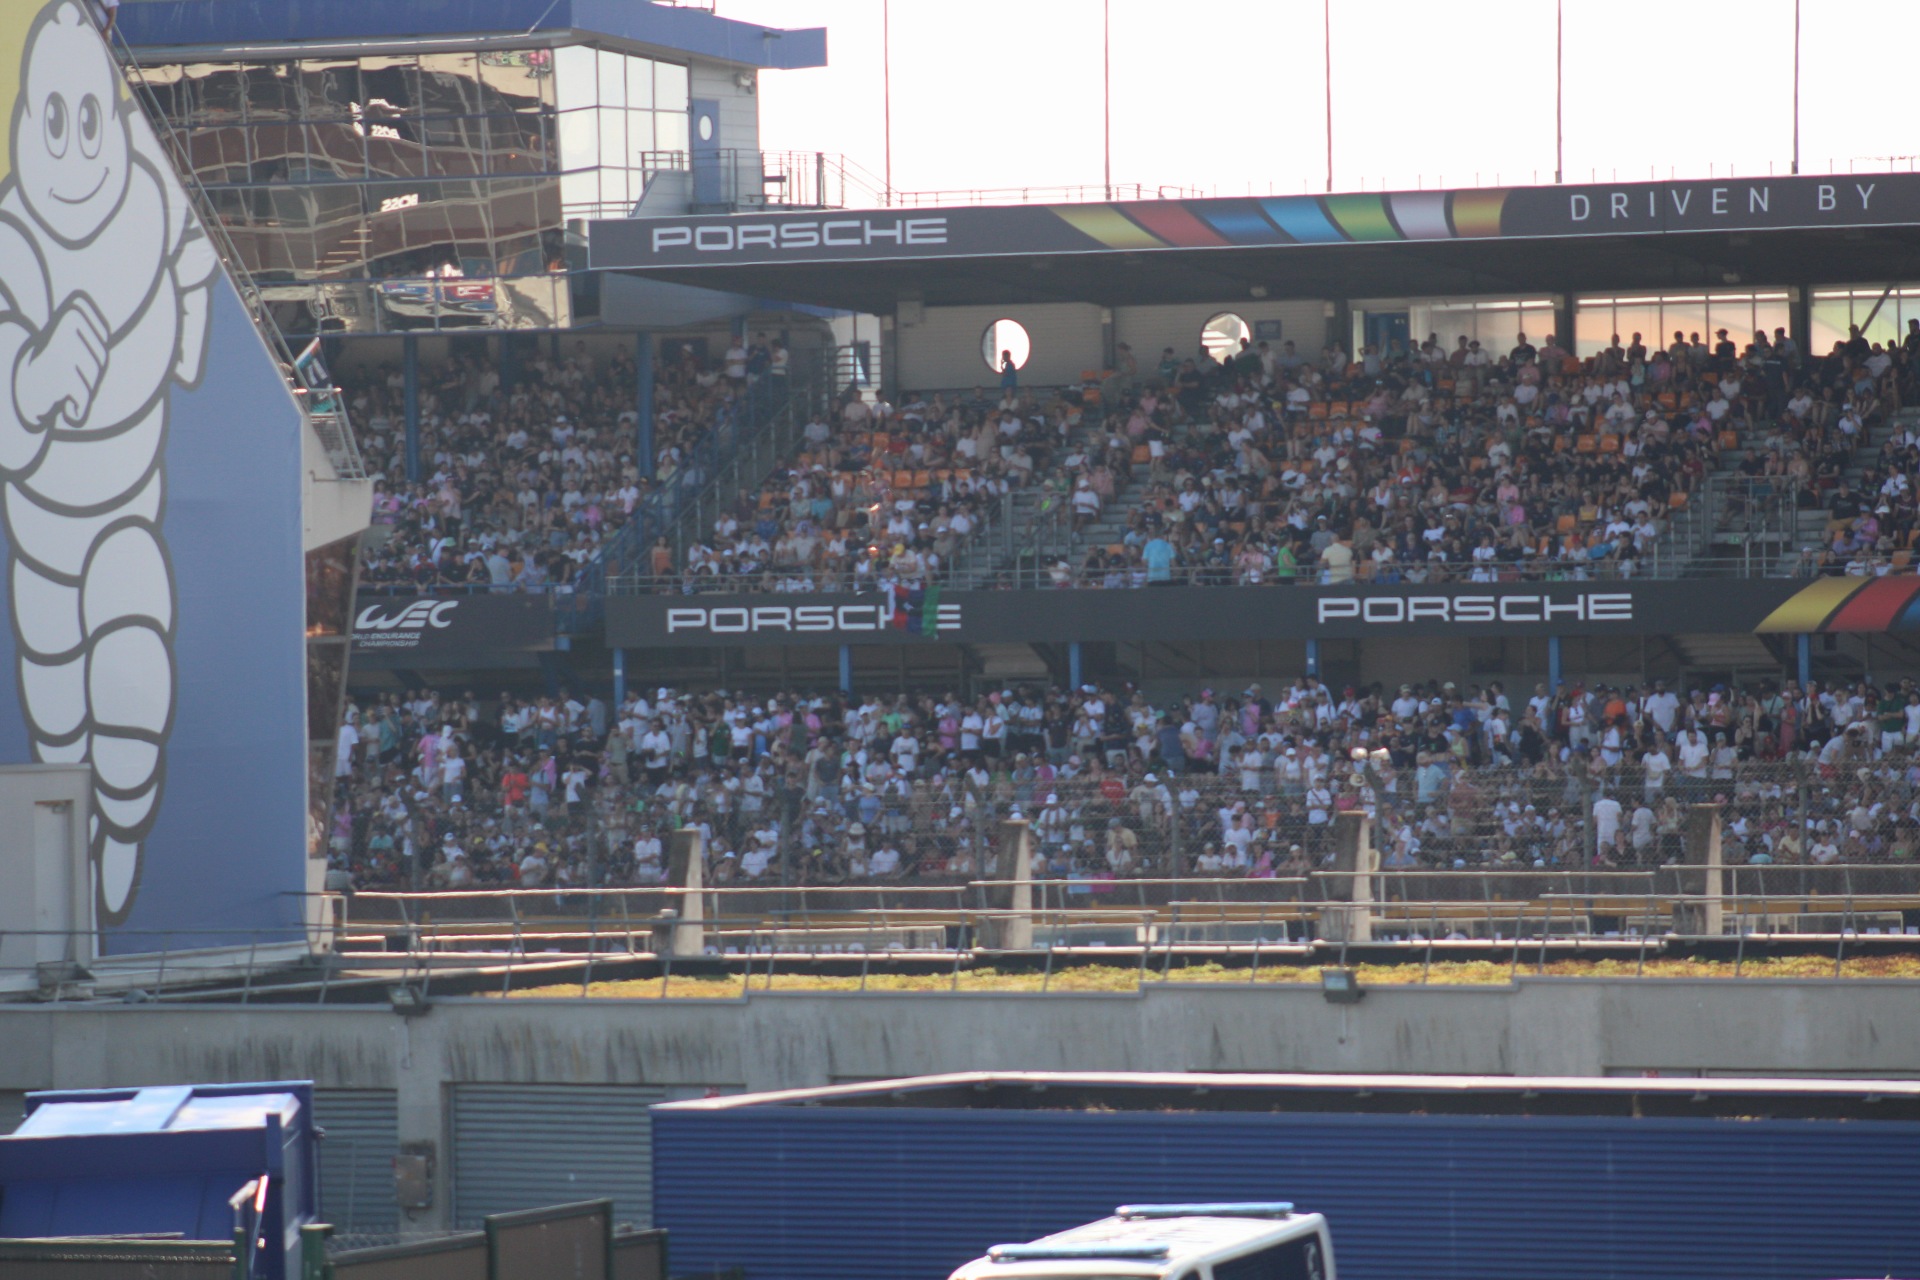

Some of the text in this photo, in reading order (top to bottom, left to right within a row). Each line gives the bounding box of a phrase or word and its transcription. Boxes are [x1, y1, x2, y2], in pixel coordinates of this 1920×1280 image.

[1570, 183, 1877, 222] DRIVEN BY
[652, 218, 948, 253] PORSCHE
[355, 600, 459, 629] WEC
[1318, 592, 1632, 623] PORSCHE
[359, 640, 419, 648] CHAMPIONSHIP
[370, 632, 422, 640] ENDURANCE
